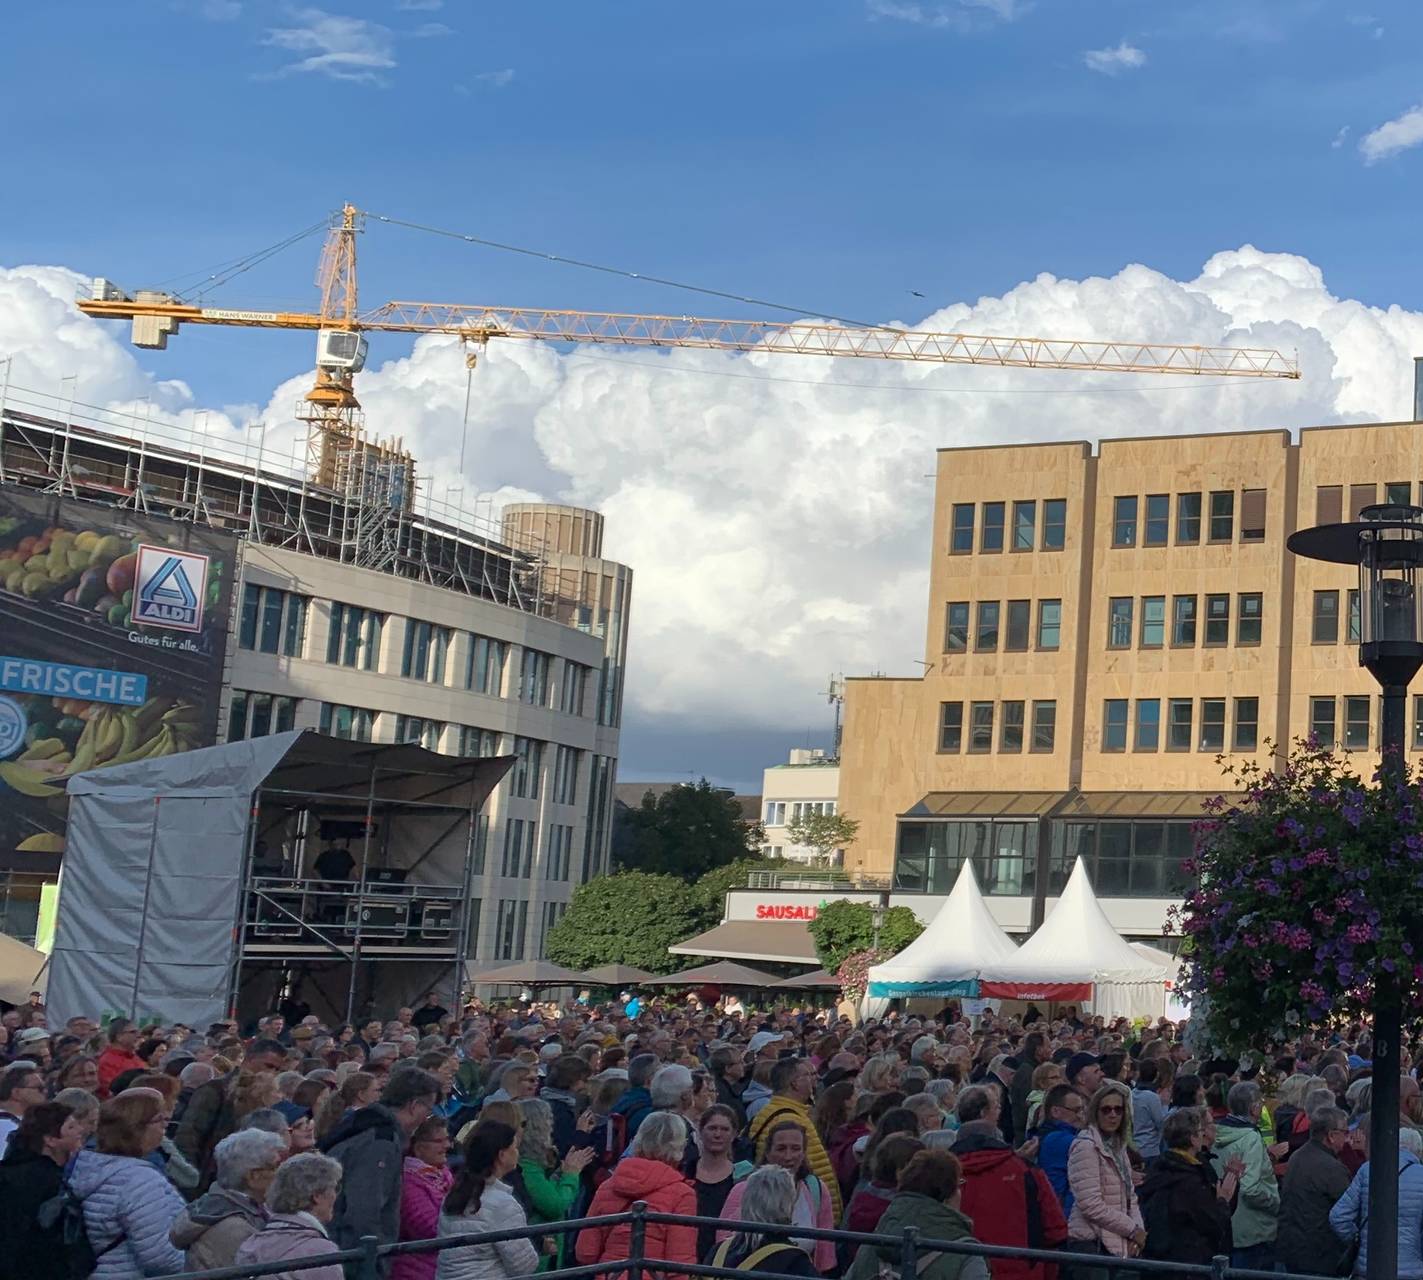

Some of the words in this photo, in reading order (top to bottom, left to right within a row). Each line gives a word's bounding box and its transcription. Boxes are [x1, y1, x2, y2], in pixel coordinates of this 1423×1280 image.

[145, 603, 192, 622] ALDI
[128, 631, 159, 646] Gutes
[162, 636, 177, 648] für
[179, 639, 200, 652] alle.
[1, 660, 142, 703] FRISCHE.
